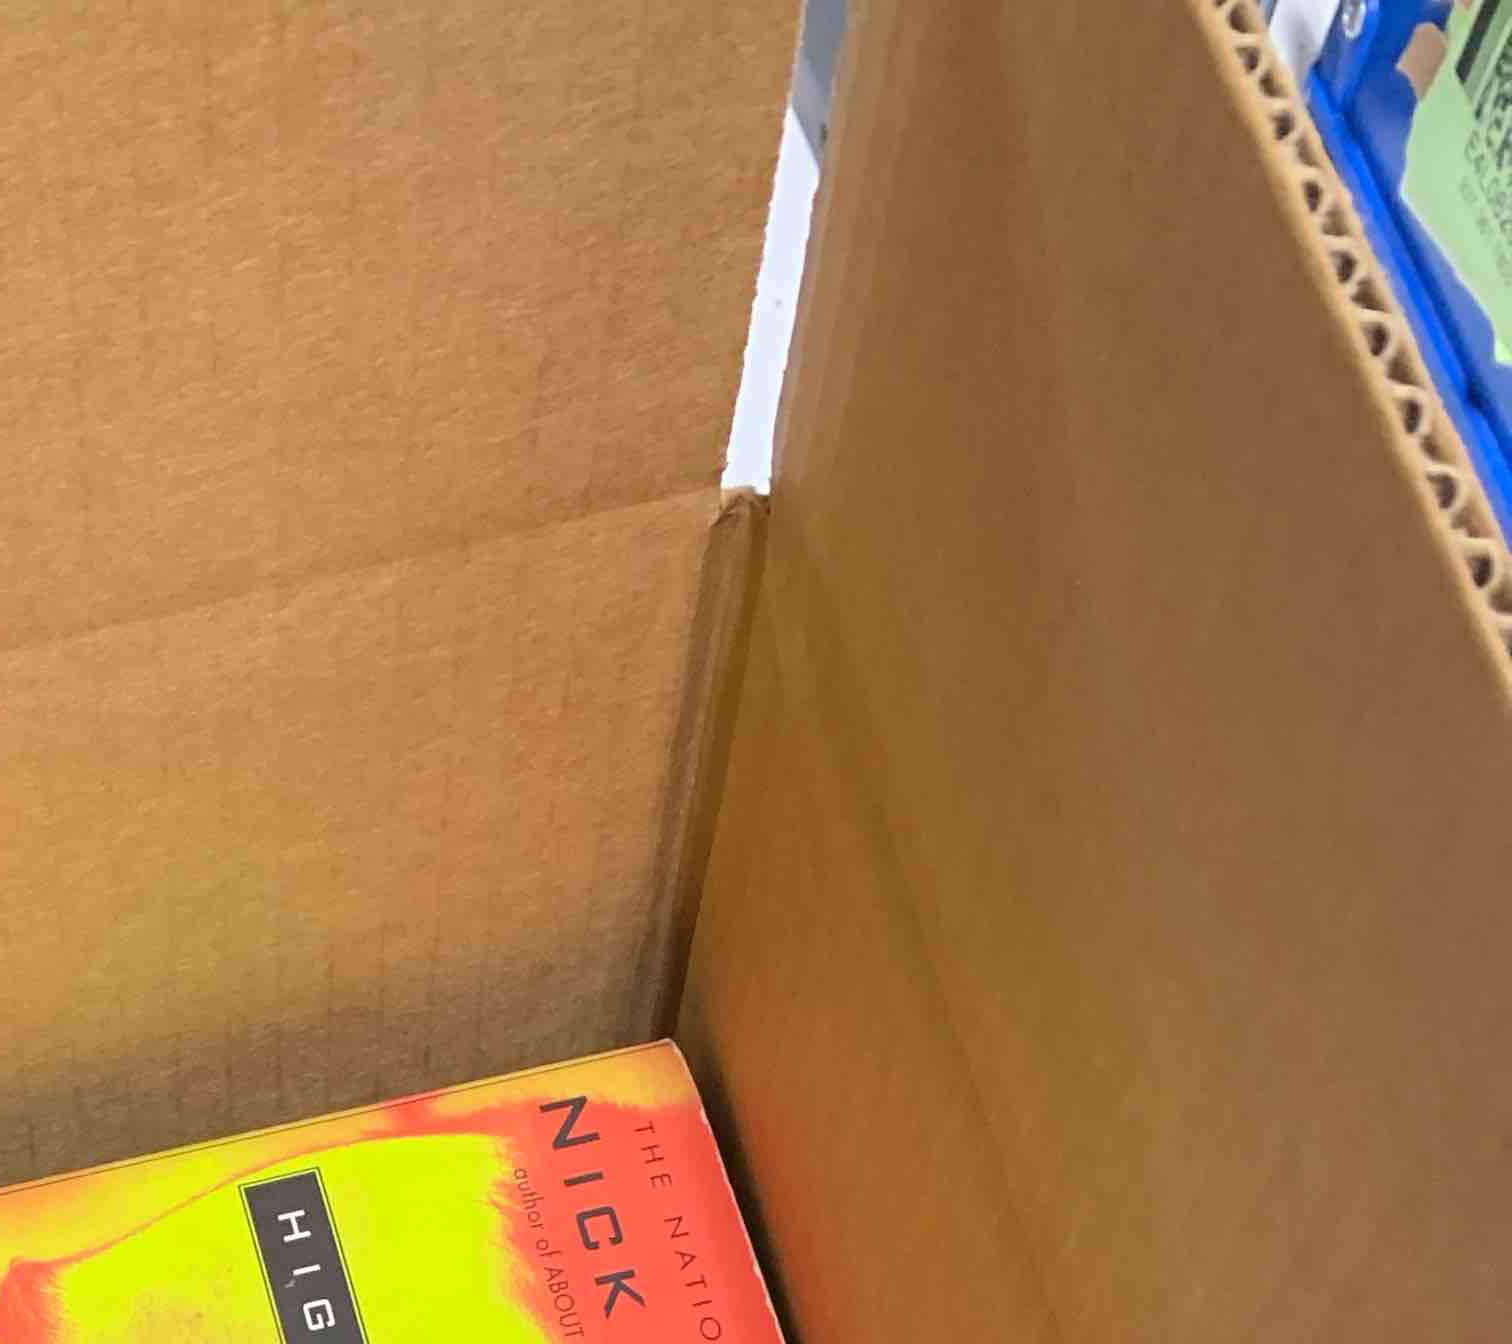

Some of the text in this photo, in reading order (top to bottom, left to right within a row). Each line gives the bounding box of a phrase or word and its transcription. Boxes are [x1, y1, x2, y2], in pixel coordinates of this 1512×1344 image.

[632, 1120, 672, 1189] THE
[513, 1166, 546, 1233] author
[539, 1094, 647, 1320] NICK
[535, 1232, 562, 1259] of
[543, 1265, 586, 1343] ABOUT
